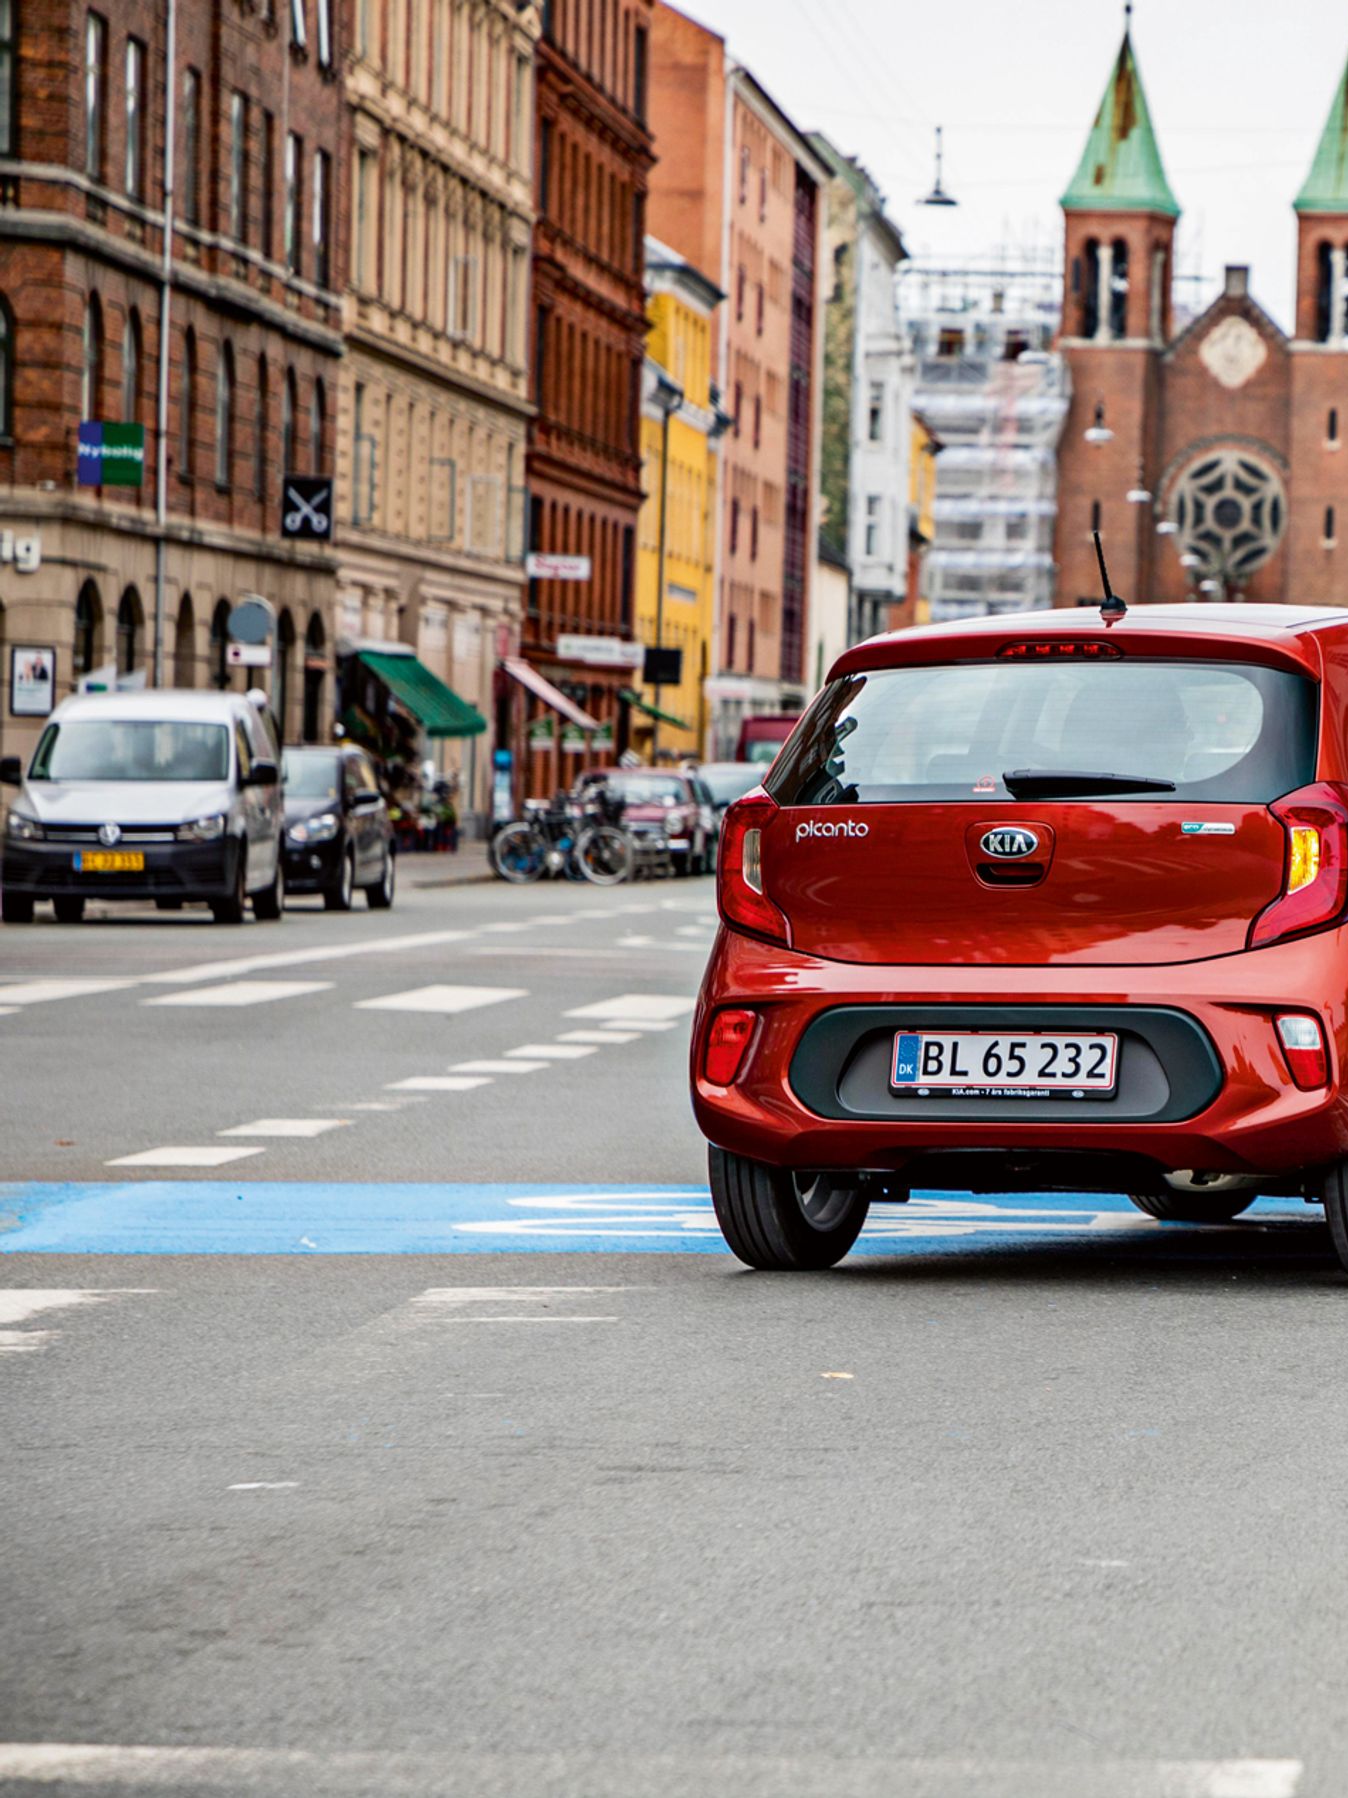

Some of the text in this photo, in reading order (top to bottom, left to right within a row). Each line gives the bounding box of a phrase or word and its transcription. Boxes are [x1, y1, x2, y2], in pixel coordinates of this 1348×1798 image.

[796, 819, 869, 843] picanto
[988, 834, 1028, 853] KIA
[921, 1039, 1108, 1079] BL 65 232
[898, 1063, 913, 1075] DK
[952, 1088, 980, 1096] KIA.com
[985, 1088, 990, 1096] 7
